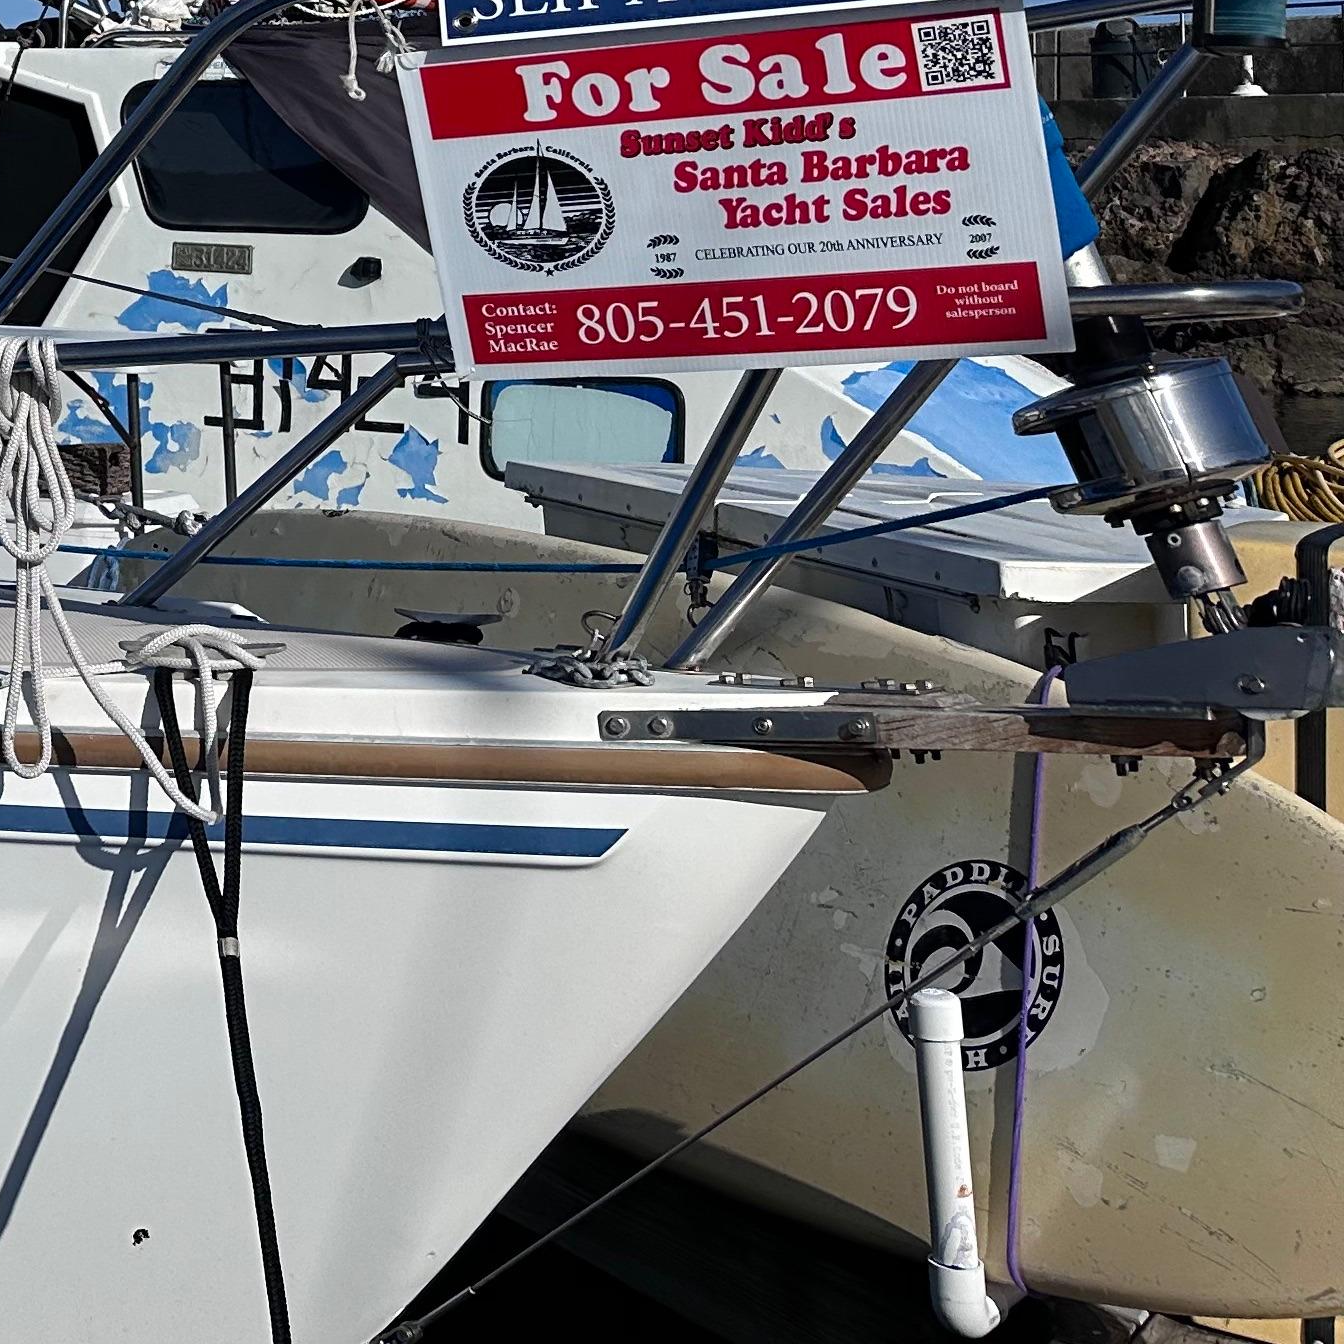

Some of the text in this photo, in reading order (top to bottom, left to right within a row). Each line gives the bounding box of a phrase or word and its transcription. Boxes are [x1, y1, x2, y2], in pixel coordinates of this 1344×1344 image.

[515, 32, 909, 123] For Sale
[619, 112, 857, 159] Sunset Kidd's
[474, 145, 594, 179] Santa Barbara California
[673, 144, 972, 194] Santa Barbara
[718, 185, 952, 230] Yacht Sales
[694, 233, 944, 261] CELEBRATING OUR 20th ANNIVERSARY
[968, 233, 993, 244] 2007
[654, 252, 678, 264] 1987
[936, 280, 1019, 295] Do not board
[954, 293, 1004, 306] without
[481, 301, 558, 318] Contact:
[575, 285, 918, 345] 805-451-2079
[945, 306, 1017, 319] salesperson
[484, 321, 555, 339] Spencer
[489, 338, 559, 354] MacRae
